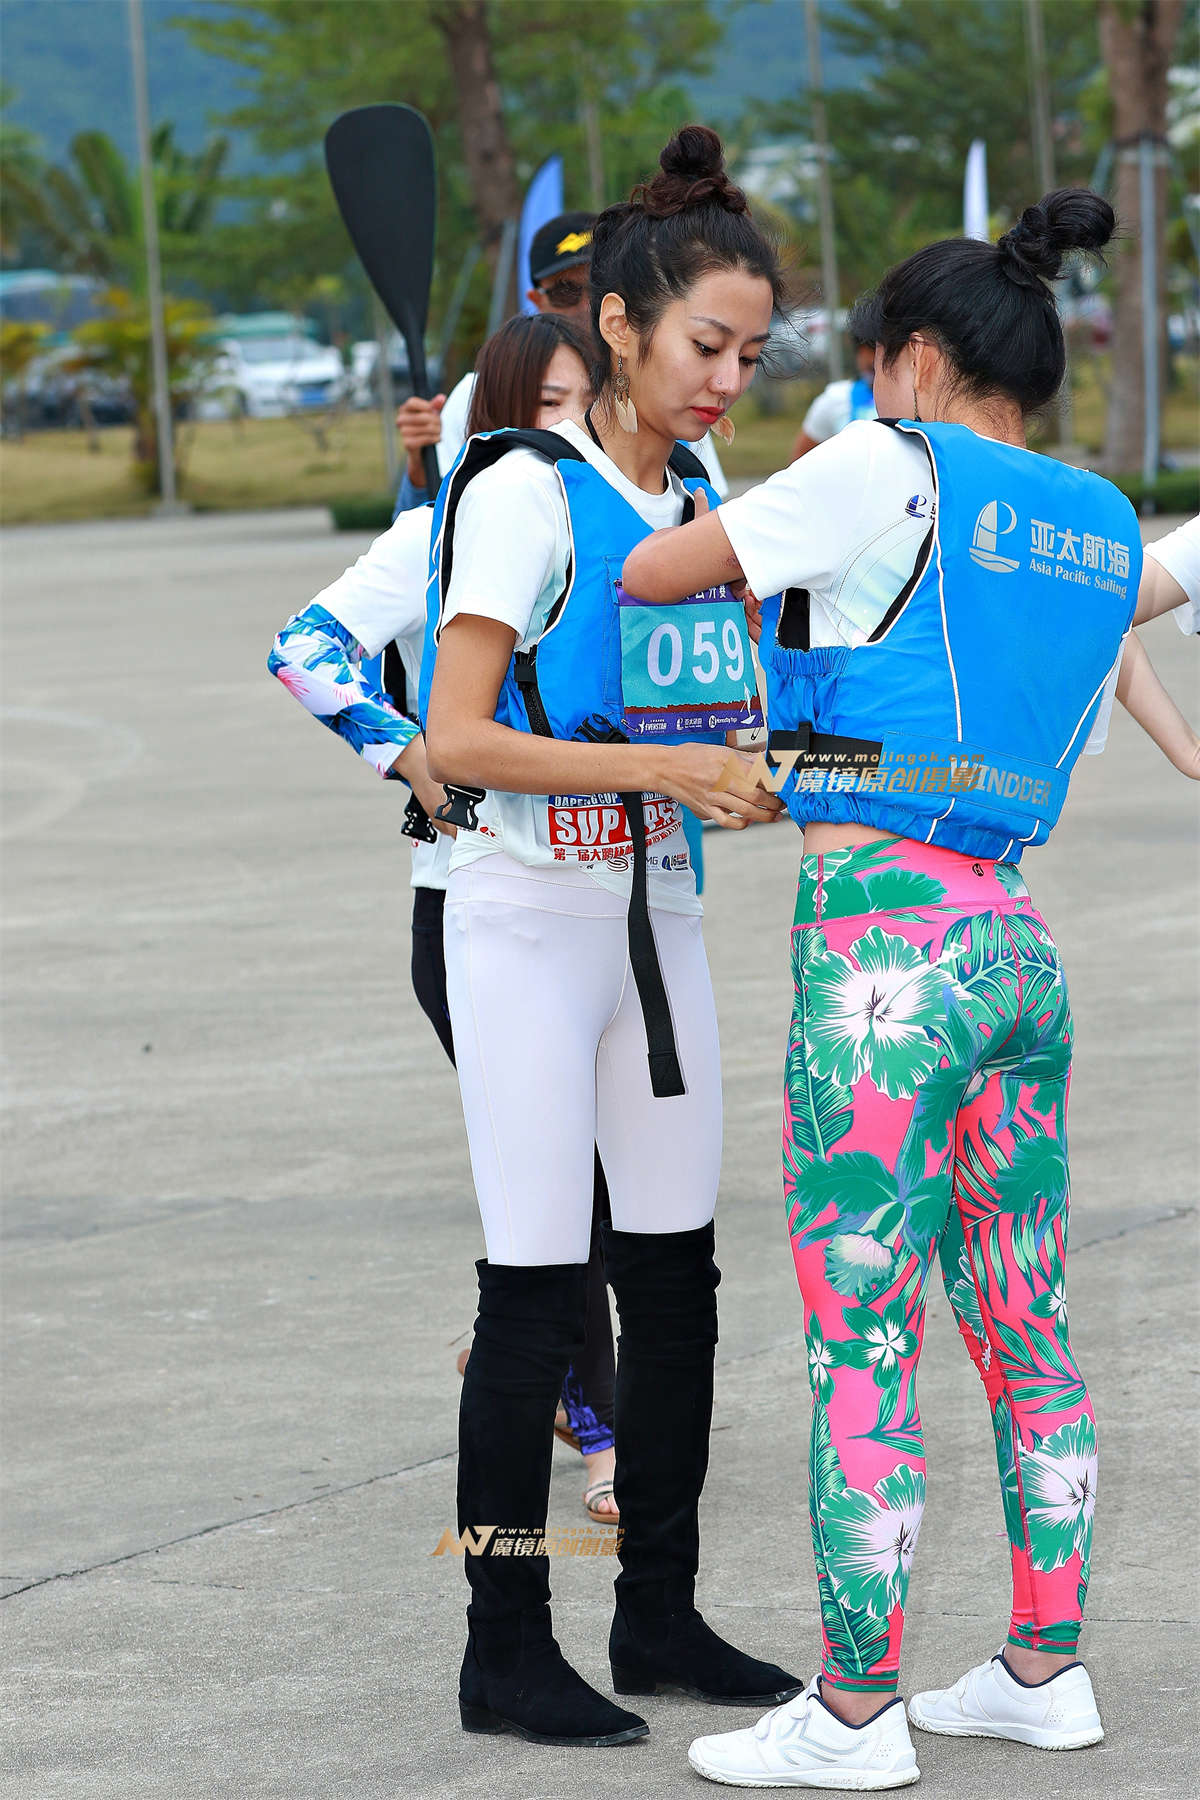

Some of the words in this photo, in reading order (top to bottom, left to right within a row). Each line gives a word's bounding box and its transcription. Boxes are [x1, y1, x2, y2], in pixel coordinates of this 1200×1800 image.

[1030, 519, 1130, 579] 亚太航海
[1029, 558, 1052, 576] Asia
[1055, 564, 1091, 586] Pacific
[1094, 575, 1128, 600] Sailing
[647, 619, 744, 687] 059
[599, 792, 619, 804] CUP
[950, 757, 1051, 807] WINDDER
[555, 808, 620, 845] SUP
